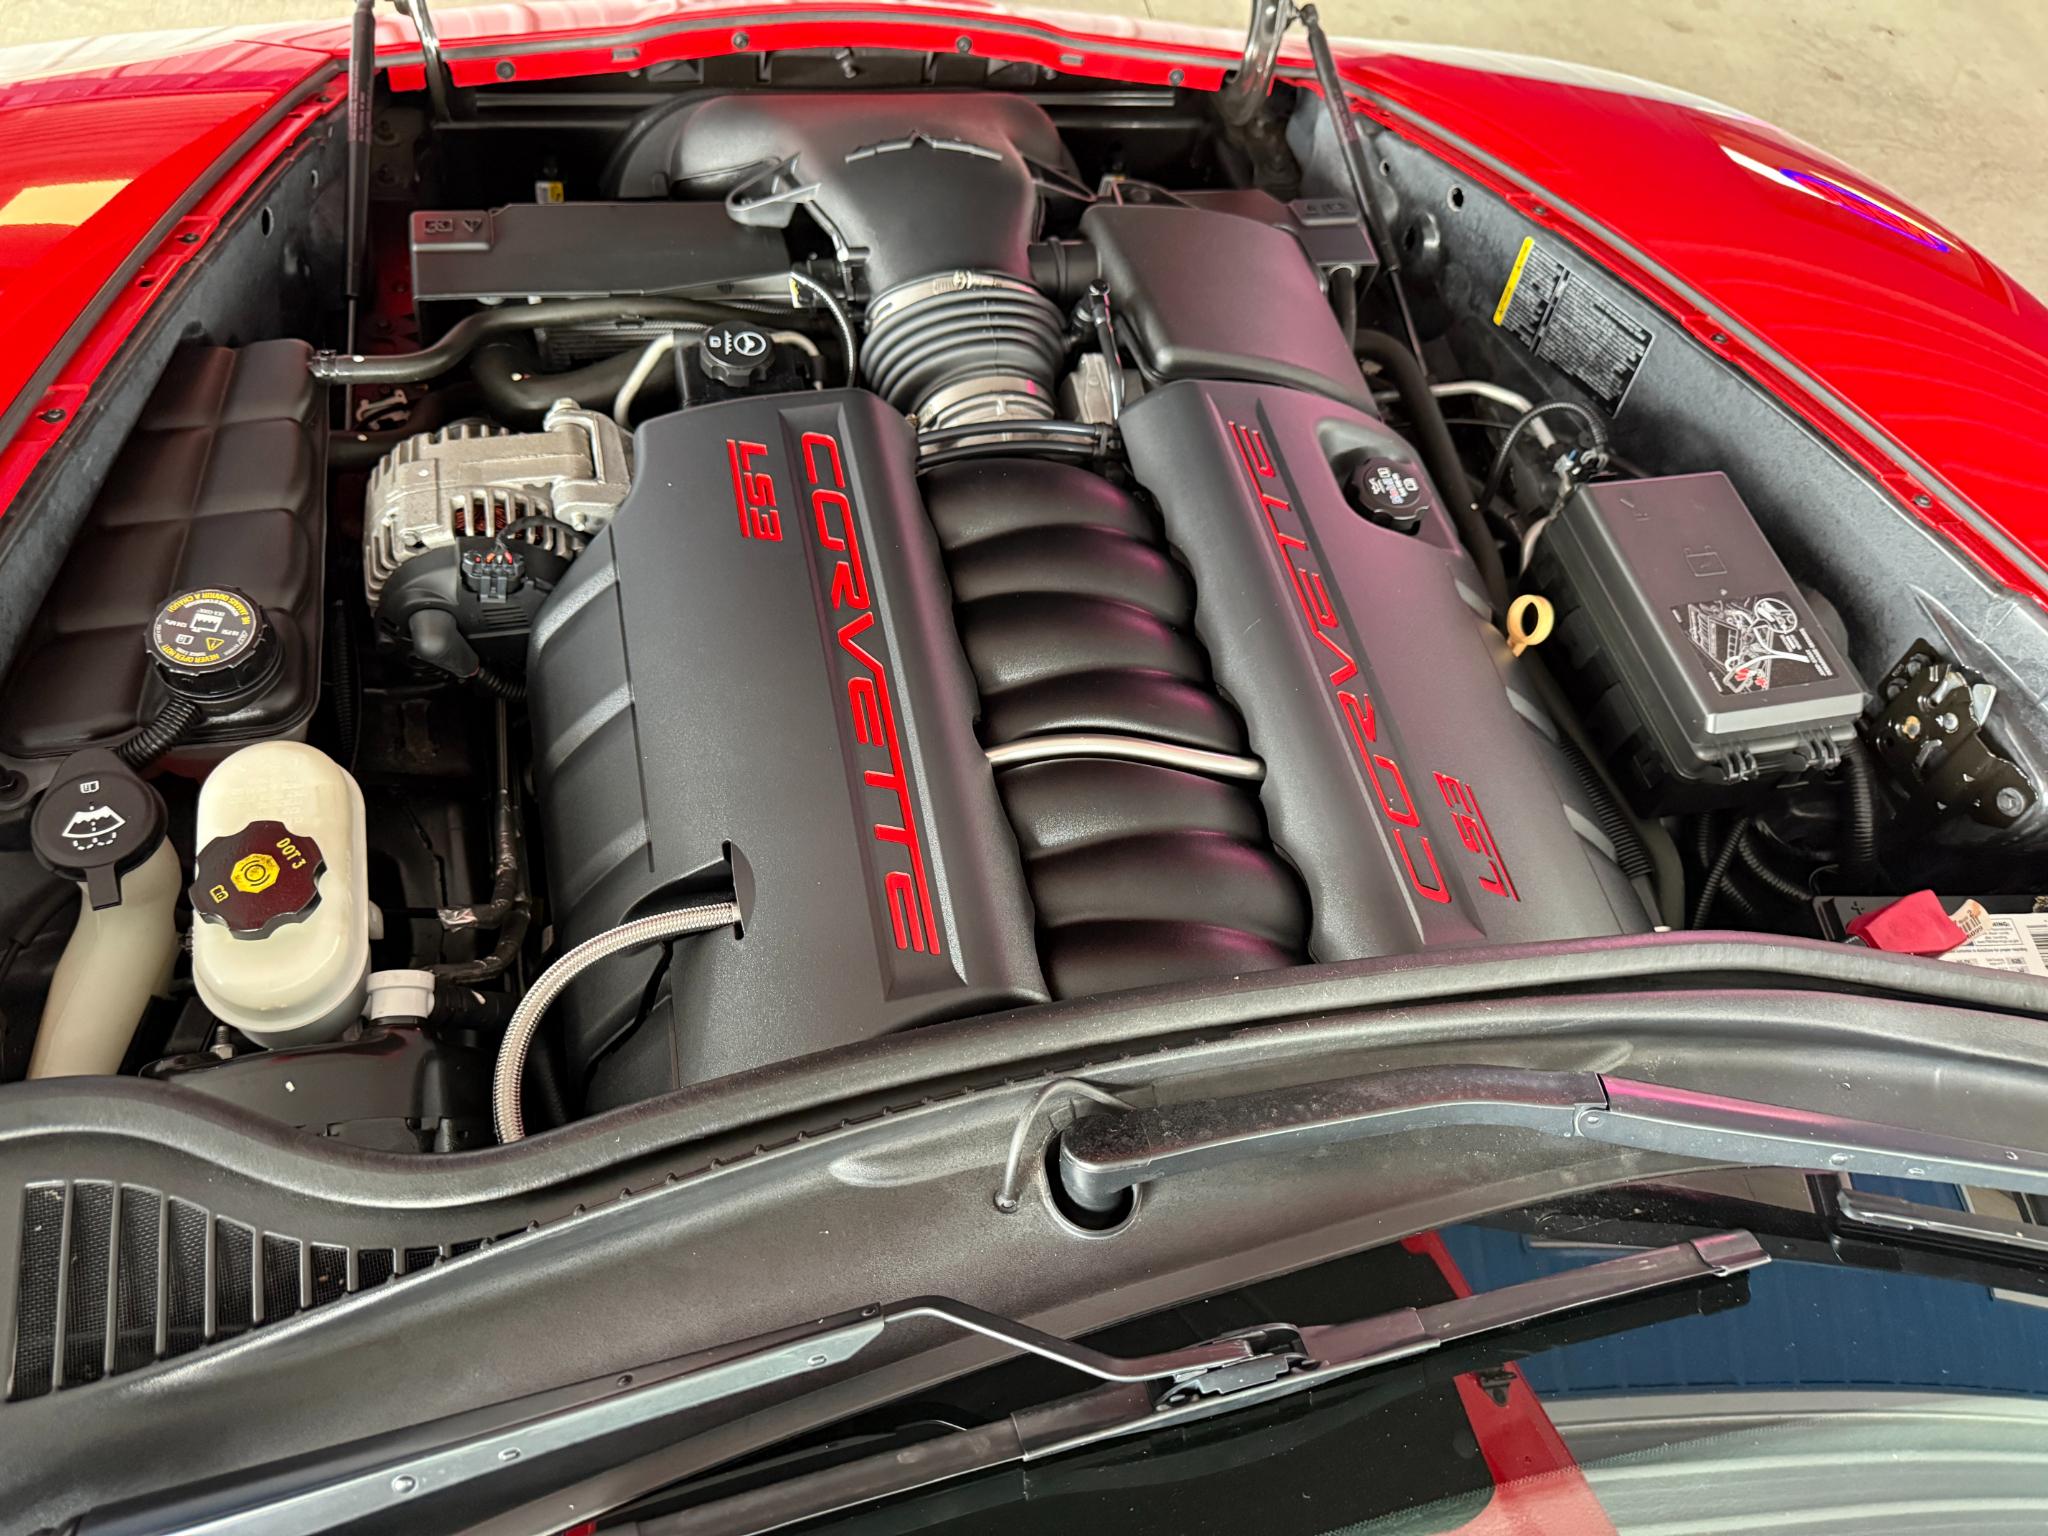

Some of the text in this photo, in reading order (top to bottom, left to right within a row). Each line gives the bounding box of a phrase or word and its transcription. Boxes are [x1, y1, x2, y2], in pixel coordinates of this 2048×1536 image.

[734, 439, 783, 542] LS3
[175, 651, 194, 663] OPEN
[195, 653, 220, 663] NEVER
[802, 432, 941, 955] CORVETTE
[1228, 421, 1452, 904] CORVETTE
[276, 837, 307, 870] DOT 3
[1433, 770, 1514, 899] LS3
